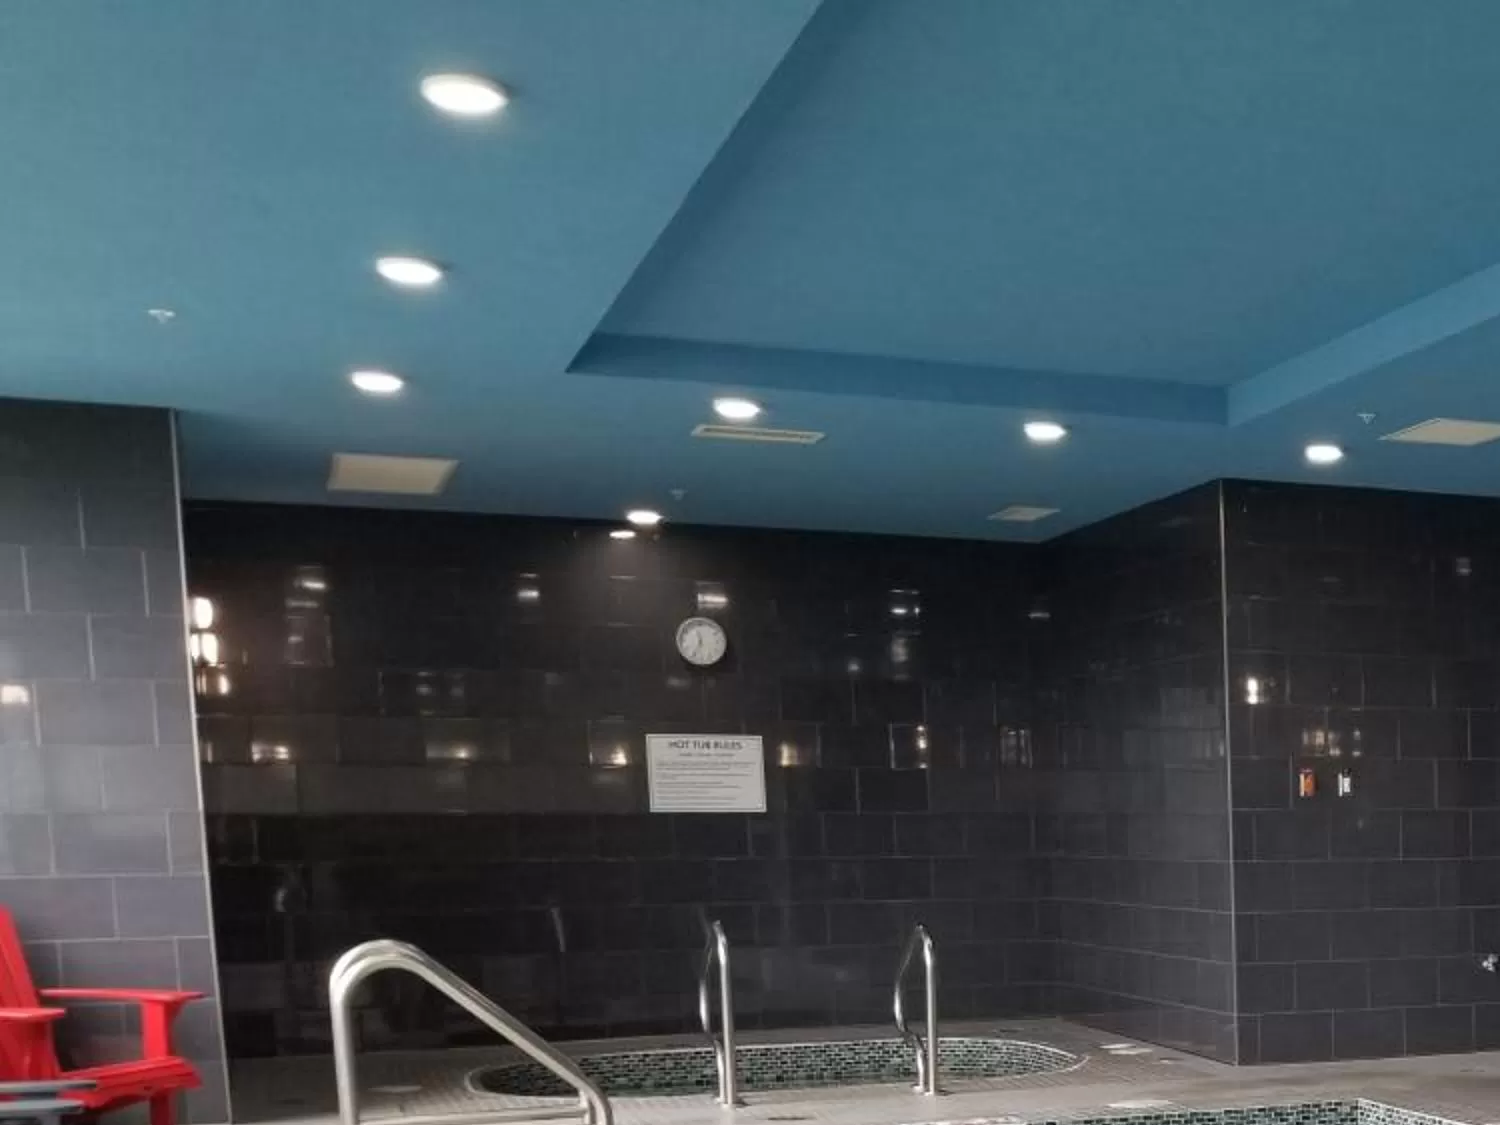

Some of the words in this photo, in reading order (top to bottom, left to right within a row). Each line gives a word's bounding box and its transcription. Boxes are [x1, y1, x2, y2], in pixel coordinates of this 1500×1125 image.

[668, 739, 689, 749] HOT
[692, 739, 711, 750] TUB
[713, 740, 743, 751] RULES
